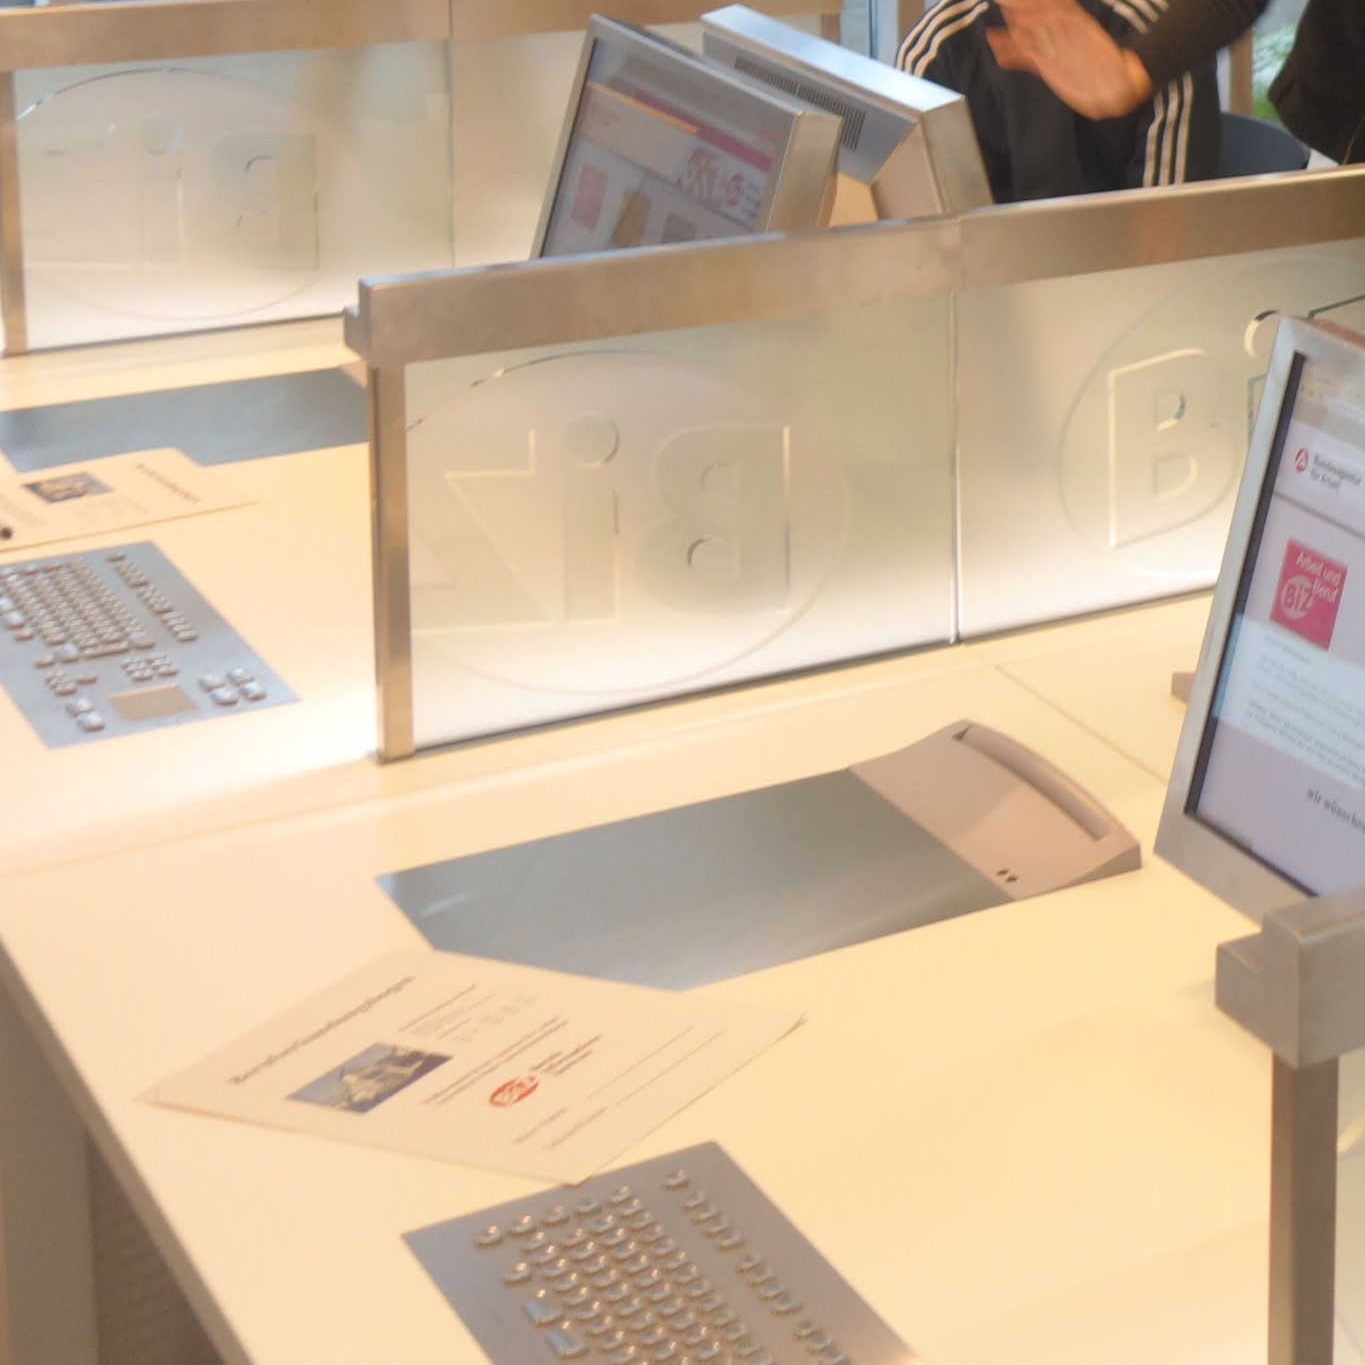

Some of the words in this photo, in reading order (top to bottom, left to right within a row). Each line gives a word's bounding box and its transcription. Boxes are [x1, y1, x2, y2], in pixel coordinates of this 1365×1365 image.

[1296, 551, 1323, 577] Arbeit
[1323, 568, 1342, 586] und
[1312, 579, 1339, 603] Beruf
[1306, 787, 1322, 805] wir
